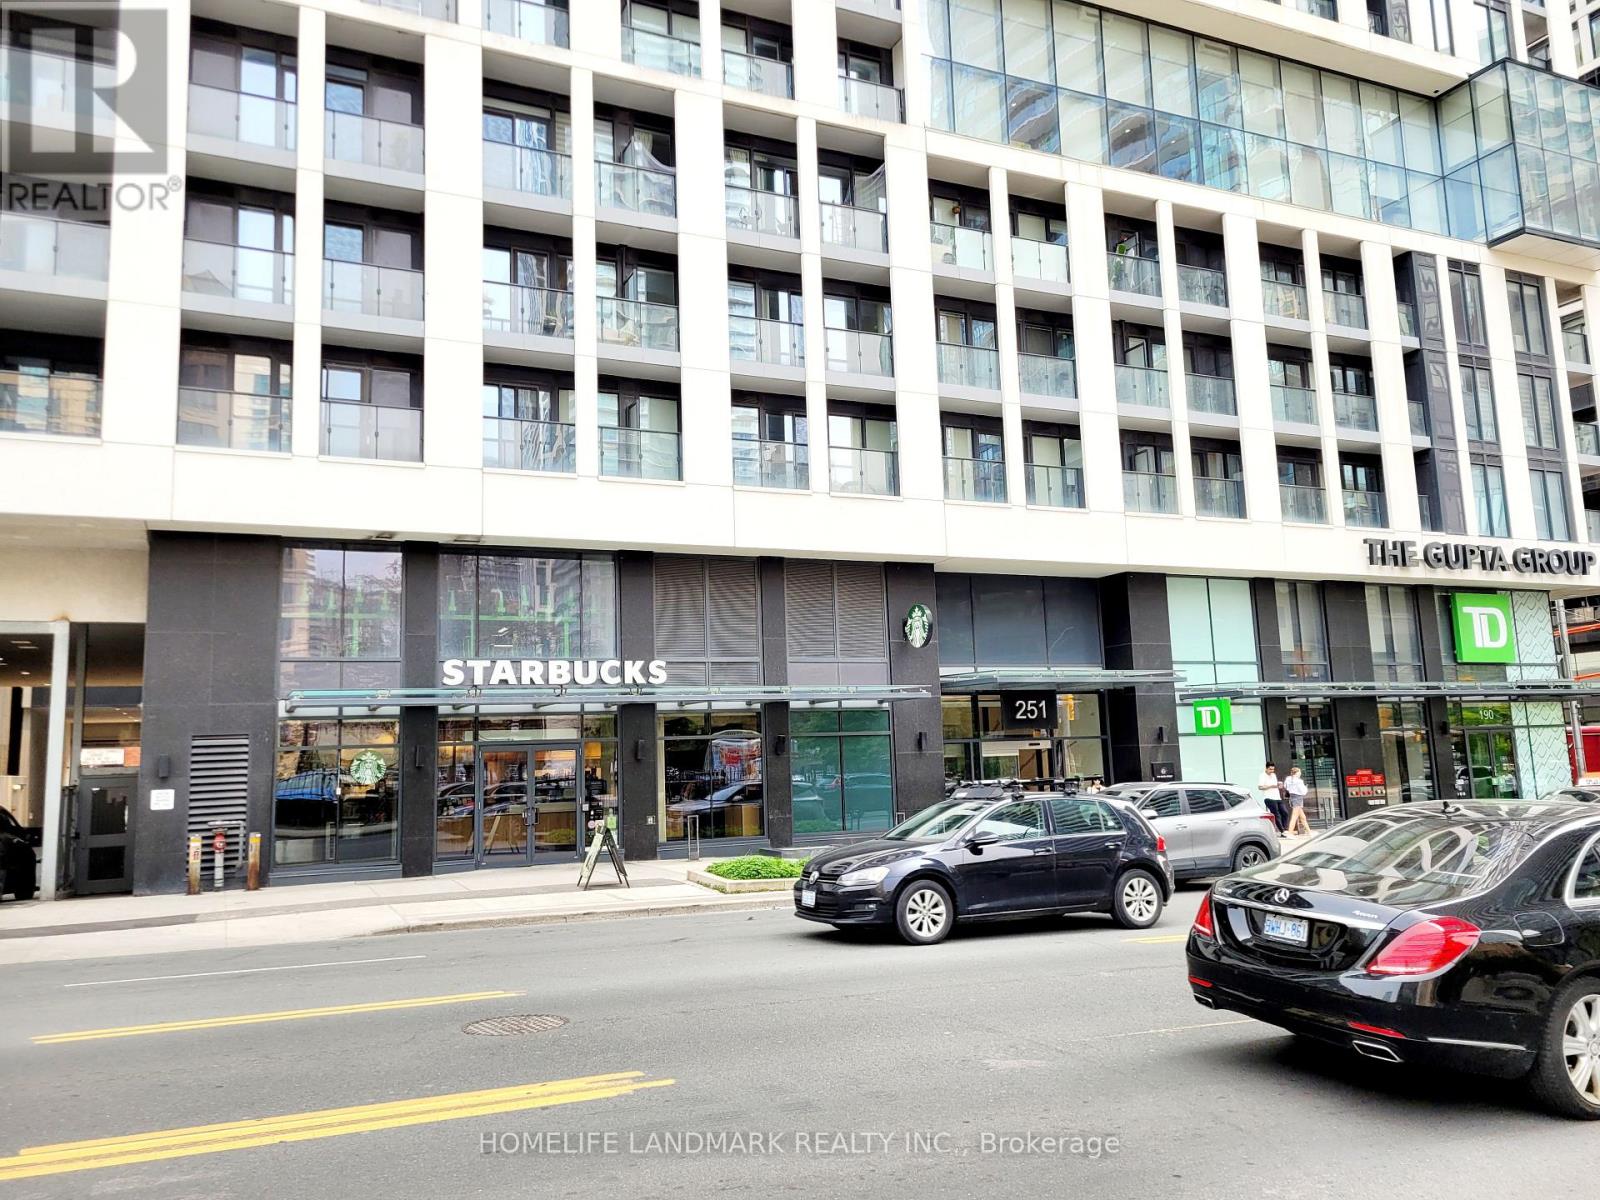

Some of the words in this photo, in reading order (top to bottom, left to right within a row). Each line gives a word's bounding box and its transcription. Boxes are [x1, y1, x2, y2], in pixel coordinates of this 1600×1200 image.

[1363, 538, 1419, 568] THE
[1423, 541, 1511, 572] GUPTA
[1512, 546, 1597, 576] GROUP
[1462, 606, 1508, 649] TD
[442, 659, 668, 686] STARBUCKS
[1015, 700, 1047, 719] 251
[1196, 706, 1221, 728] TD
[1479, 709, 1494, 720] 190
